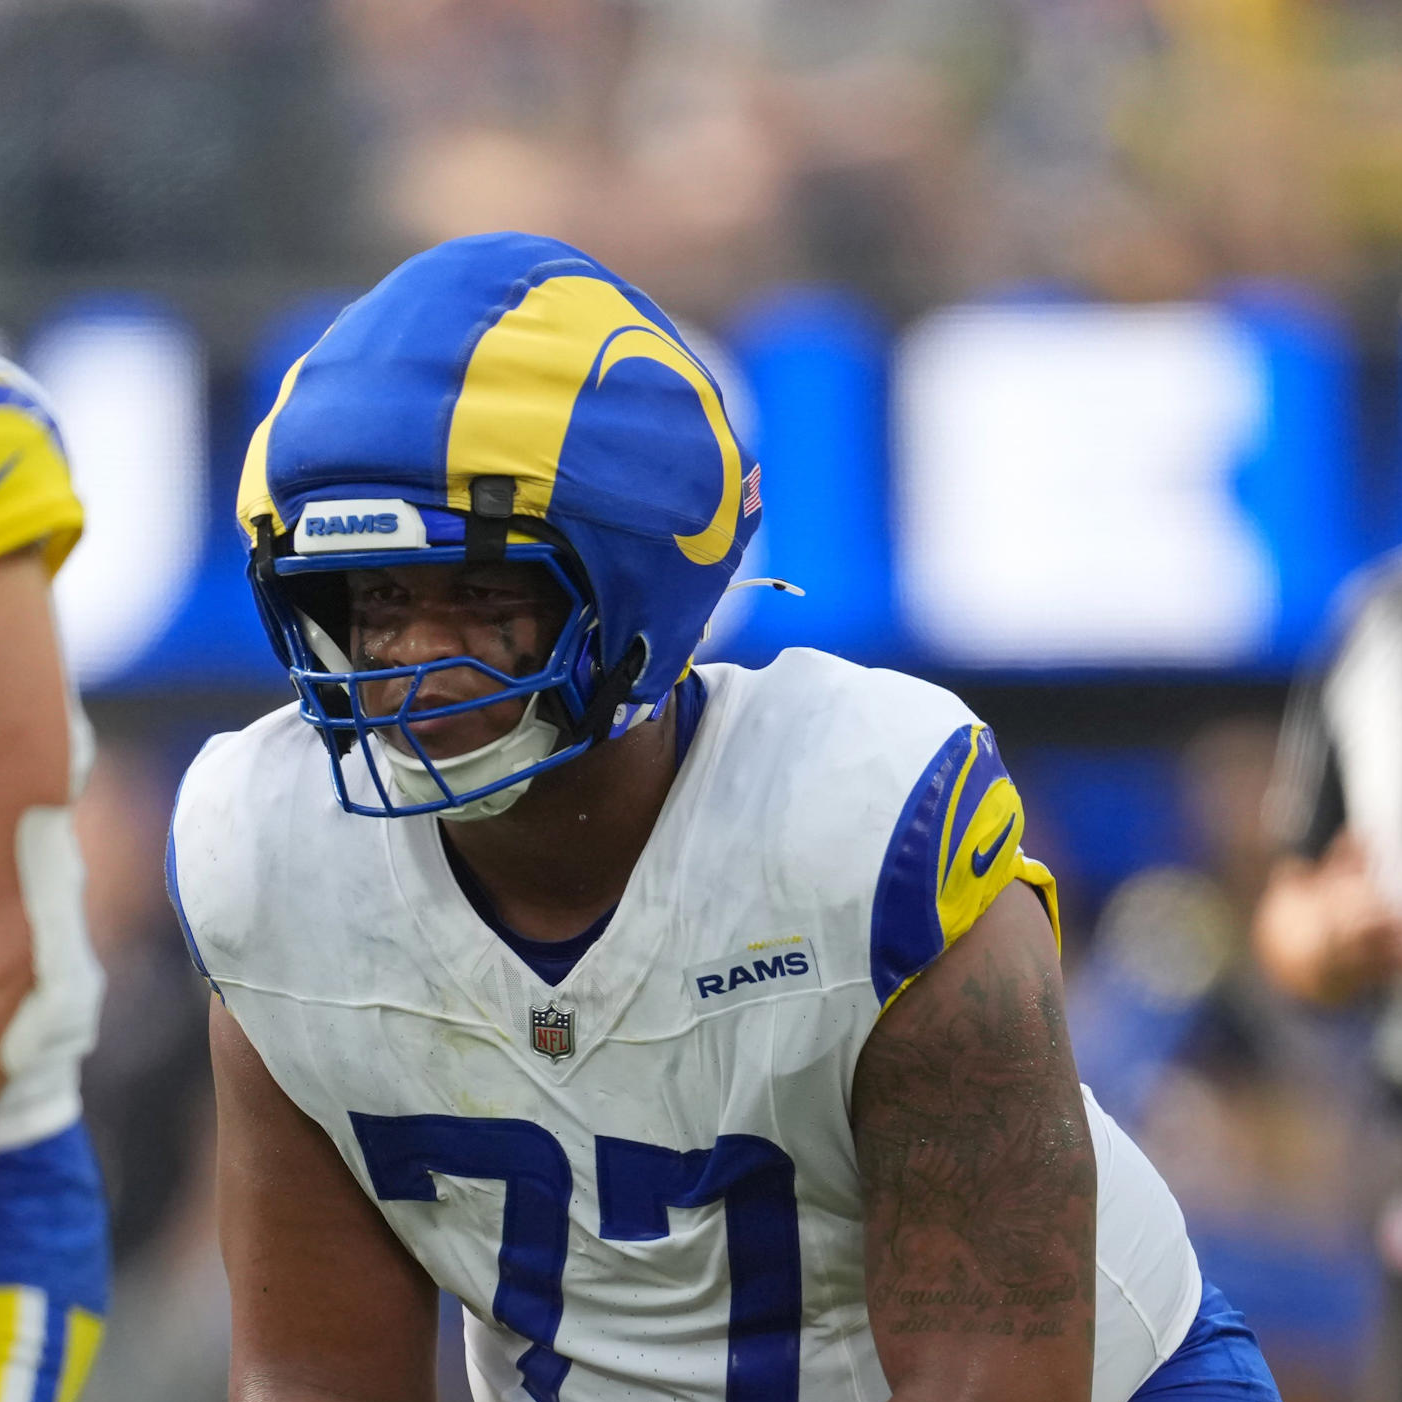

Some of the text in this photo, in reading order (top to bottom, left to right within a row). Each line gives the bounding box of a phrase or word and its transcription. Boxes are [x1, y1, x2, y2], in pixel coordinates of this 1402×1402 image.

[306, 513, 398, 537] RAMS
[696, 952, 809, 999] RAMS
[535, 1027, 568, 1053] NFL
